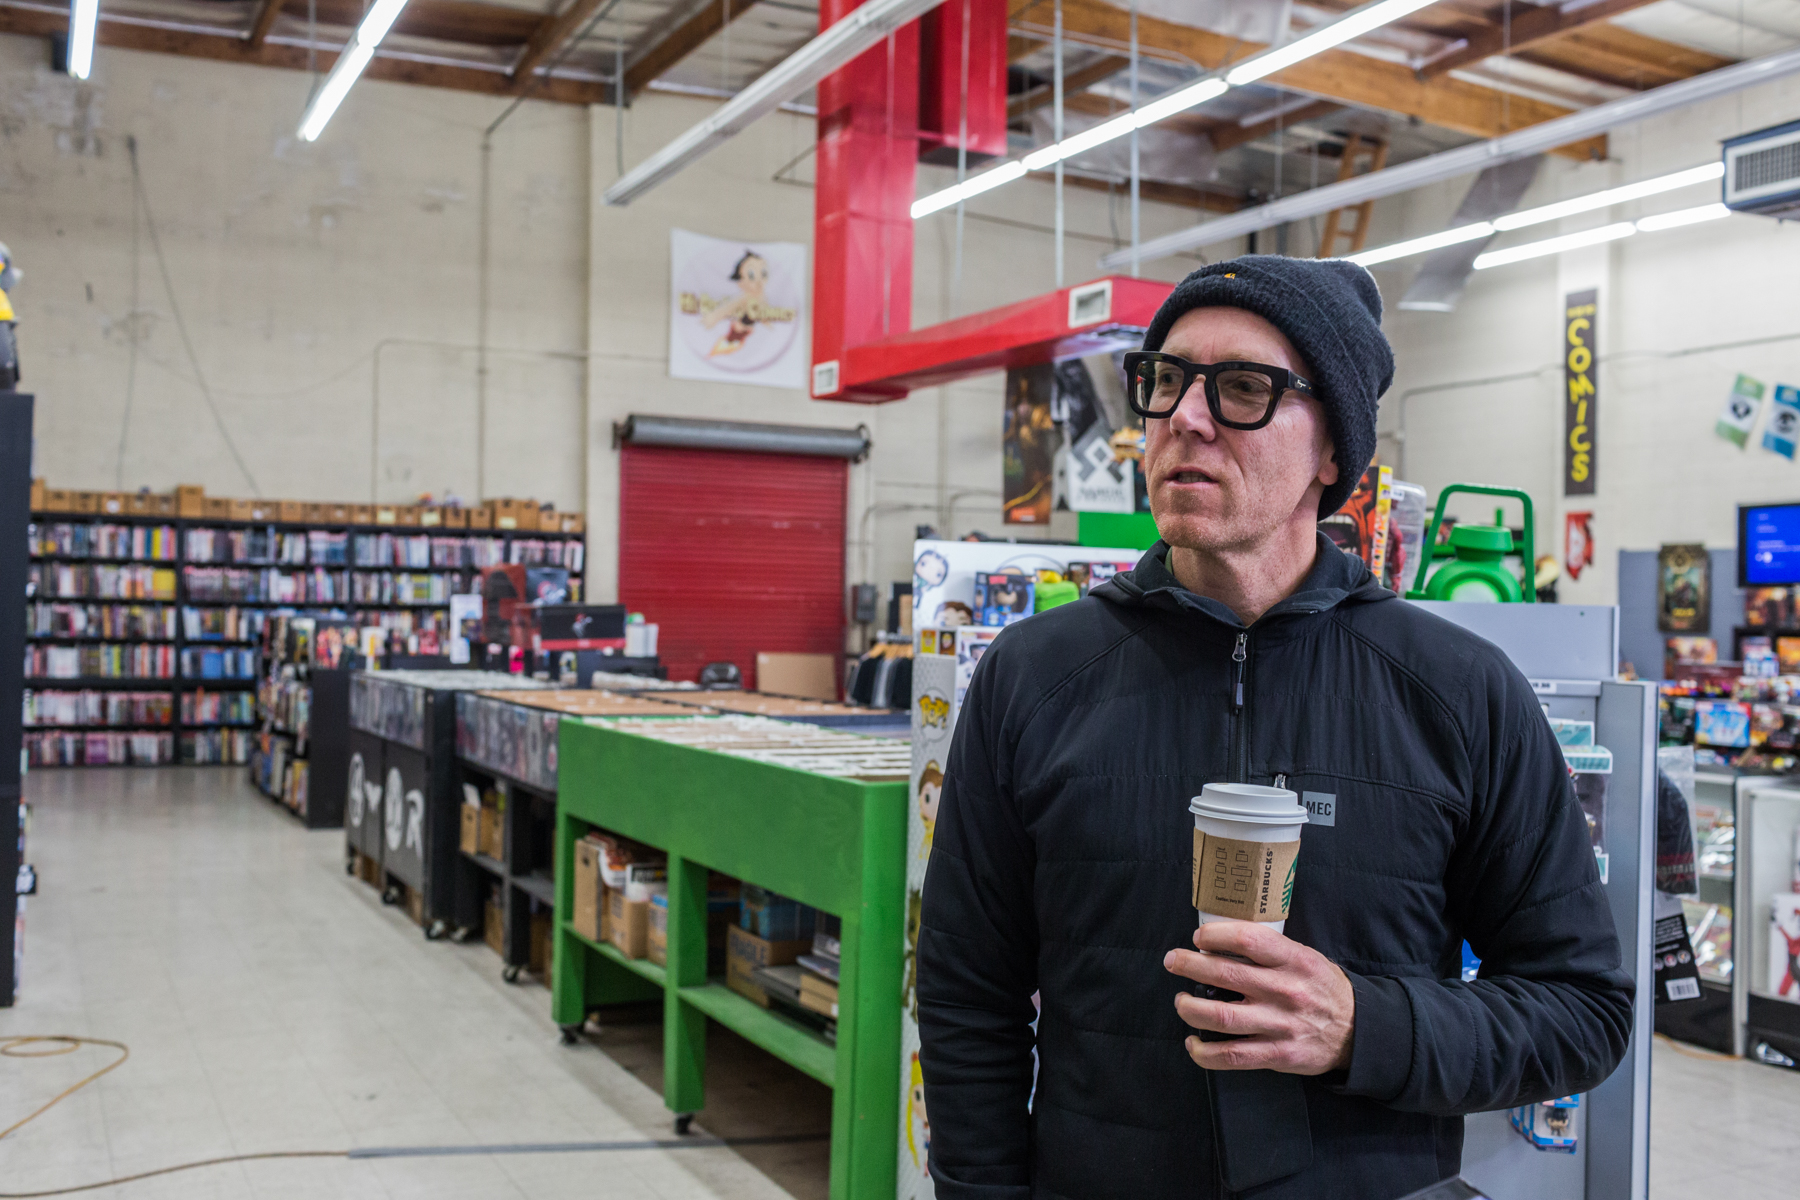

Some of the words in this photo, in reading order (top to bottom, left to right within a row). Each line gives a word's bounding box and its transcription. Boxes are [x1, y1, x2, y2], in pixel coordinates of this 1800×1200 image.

[1567, 317, 1595, 483] COMICS
[1306, 801, 1332, 817] MEC
[1260, 850, 1274, 914] STARBUCKS
